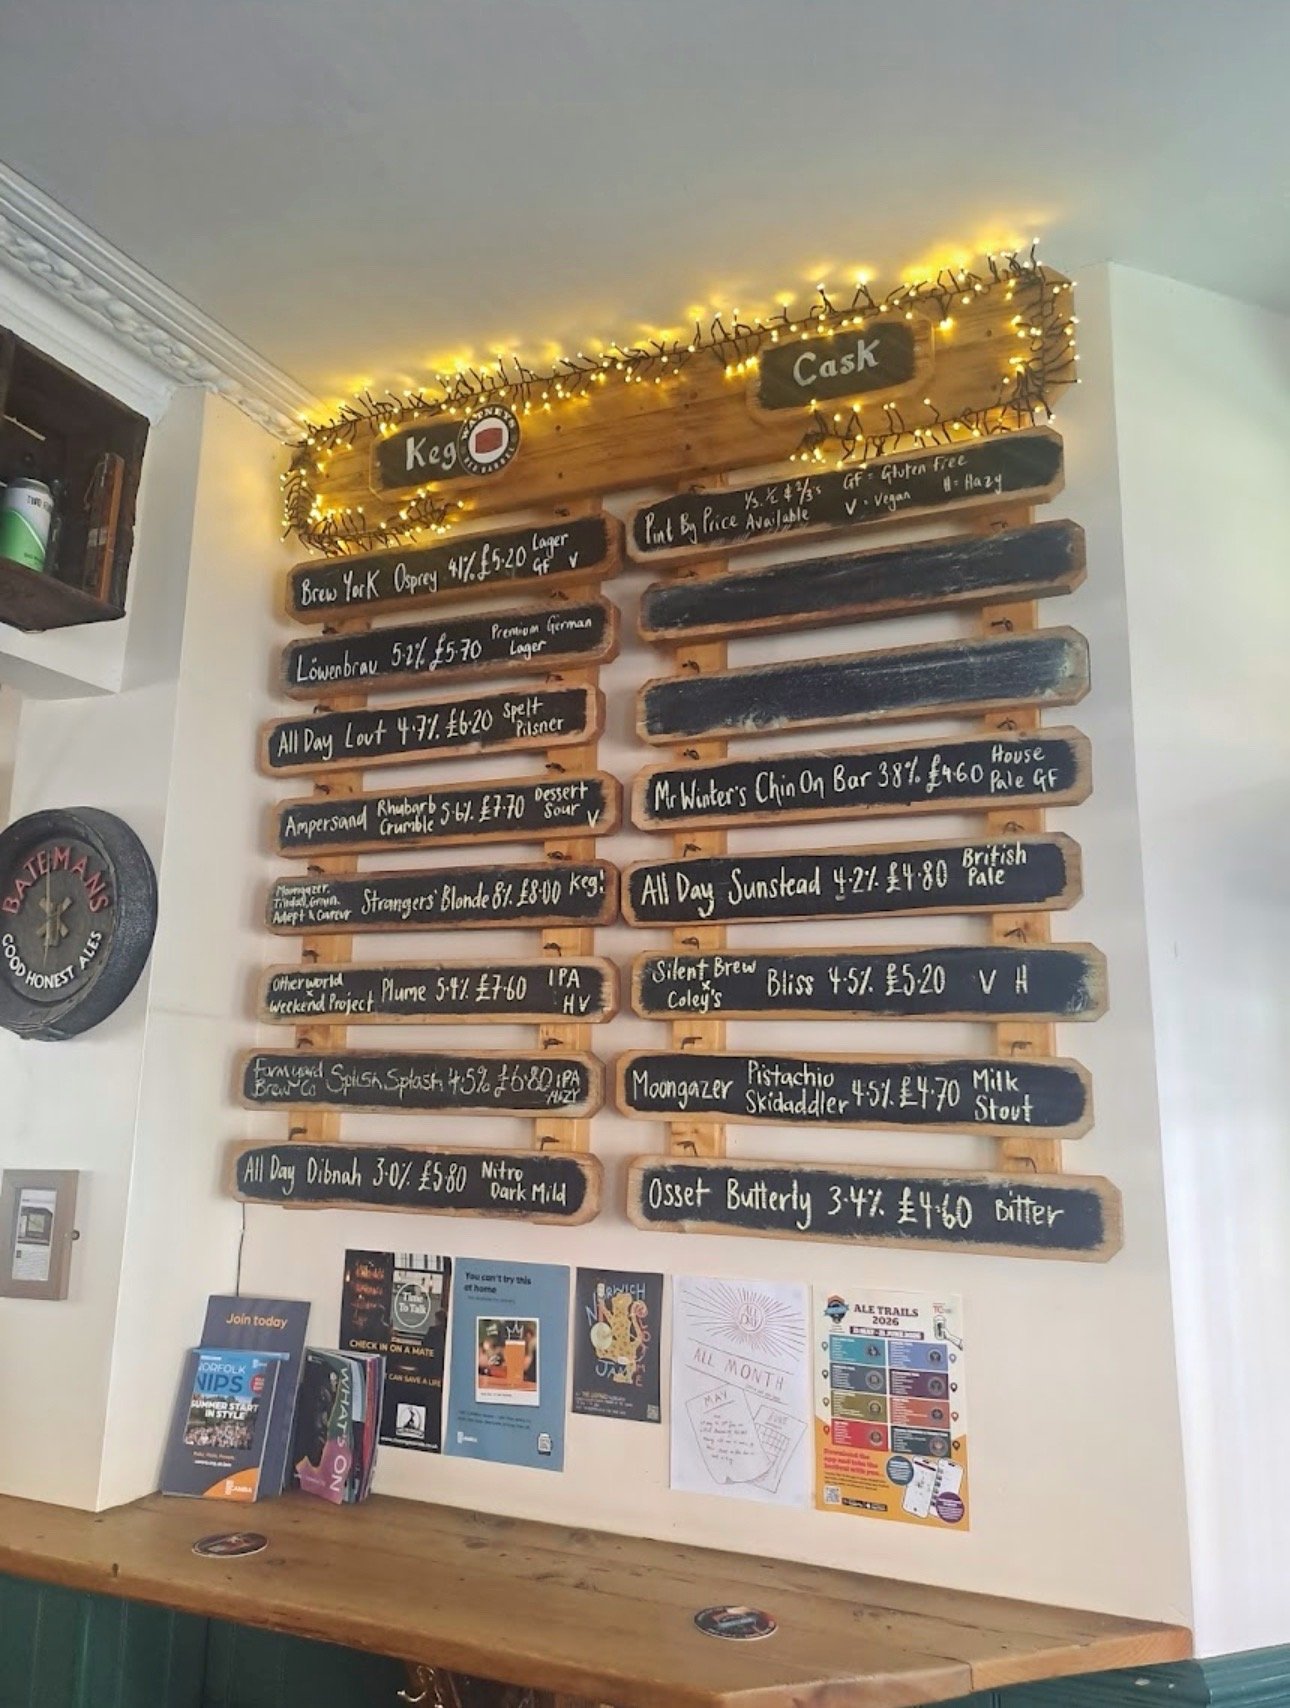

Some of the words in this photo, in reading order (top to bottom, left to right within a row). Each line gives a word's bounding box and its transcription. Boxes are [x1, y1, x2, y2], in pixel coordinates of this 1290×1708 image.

[406, 436, 457, 471] Keg
[843, 471, 863, 490] GF
[881, 462, 927, 485] Gluten
[933, 455, 968, 473] Free
[943, 476, 951, 492] H
[965, 473, 1003, 496] Hazy
[845, 499, 857, 516] V
[874, 490, 912, 512] Vegan
[644, 516, 673, 545] Pint
[680, 512, 698, 544] By
[702, 506, 737, 533] Price
[746, 505, 810, 530] Available
[532, 532, 569, 559] Lager
[533, 557, 550, 576] GF
[569, 550, 578, 569] V
[301, 579, 337, 606] Brew
[394, 561, 439, 594] Osprey
[491, 623, 539, 640] Premium
[546, 615, 592, 635] German
[510, 639, 547, 660] Lager
[296, 650, 378, 682] Löwenbrau
[516, 717, 565, 738] Pilsner
[278, 732, 298, 757] All
[304, 727, 333, 760] Day
[991, 743, 1045, 763] House
[535, 780, 588, 801] Dessert
[653, 781, 676, 811] Mr
[679, 780, 747, 811] Winter's
[755, 771, 796, 806] Chin
[799, 770, 826, 799] On
[833, 763, 871, 792] Bar
[989, 770, 1025, 793] Pale
[1032, 767, 1060, 786] GF
[377, 794, 436, 817] Rhubarb
[544, 801, 581, 819] Sour
[587, 809, 599, 828] V
[285, 804, 367, 839] Ampersand
[380, 816, 433, 836] Crumble
[961, 845, 1027, 868] British
[2, 846, 109, 914] BATEMANS
[569, 869, 605, 897] Keg!
[967, 867, 1006, 888] Pale
[361, 887, 438, 920] Strangers'
[440, 882, 487, 912] Blonde
[492, 881, 513, 909] 8%
[641, 878, 669, 906] All
[675, 872, 716, 919] Day
[728, 866, 821, 906] Sunstead
[2, 933, 27, 978] GOOD
[25, 964, 75, 989] HONEST
[79, 931, 103, 970] ALES
[652, 957, 709, 983] Silent
[713, 958, 757, 978] Brew
[381, 976, 427, 1003] Plume
[549, 968, 580, 988] IPA
[767, 968, 814, 997] Bliss
[978, 970, 997, 994] V
[1015, 965, 1028, 994] H
[329, 990, 374, 1015] Project
[563, 995, 574, 1014] H
[578, 994, 590, 1013] V
[667, 989, 723, 1015] Coley's
[555, 1069, 580, 1087] IPA
[748, 1060, 835, 1089] Pistachio
[973, 1069, 1019, 1092] Milk
[632, 1069, 733, 1110] Moongazer
[746, 1089, 849, 1117] Skidaddler
[974, 1094, 1034, 1122] Stout
[244, 1158, 264, 1183] All
[270, 1156, 295, 1195] Day
[306, 1156, 362, 1187] Dibnah
[480, 1160, 523, 1181] Nitro
[491, 1181, 525, 1200] Dark
[532, 1183, 567, 1206] Mild
[649, 1176, 710, 1210] Osset
[726, 1178, 811, 1230] Butterly
[995, 1190, 1065, 1228] Bitter
[465, 1272, 480, 1281] You
[481, 1274, 502, 1282] can't
[504, 1275, 515, 1285] try
[516, 1275, 532, 1285] this
[474, 1284, 497, 1293] home
[399, 1302, 409, 1311] To
[409, 1304, 426, 1314] Talk
[402, 1292, 424, 1303] Time
[585, 1282, 646, 1327] NRWICH
[854, 1304, 875, 1314] ALE
[876, 1306, 919, 1317] TRAILS
[226, 1313, 251, 1324] Join
[253, 1315, 288, 1329] today
[872, 1315, 899, 1326] 2026
[349, 1339, 378, 1350] CHECK
[389, 1344, 402, 1352] ON
[404, 1346, 412, 1354] A
[412, 1347, 435, 1358] MATE
[694, 1347, 714, 1367] ALL
[388, 1373, 403, 1382] CAN
[405, 1375, 421, 1384] SAVE
[428, 1378, 441, 1387] LIFE
[724, 1358, 784, 1391] MONTH
[228, 1402, 259, 1413] START
[704, 1390, 728, 1406] MAY
[205, 1409, 215, 1418] IN
[216, 1410, 247, 1420] STYLE
[329, 1455, 348, 1492] ON
